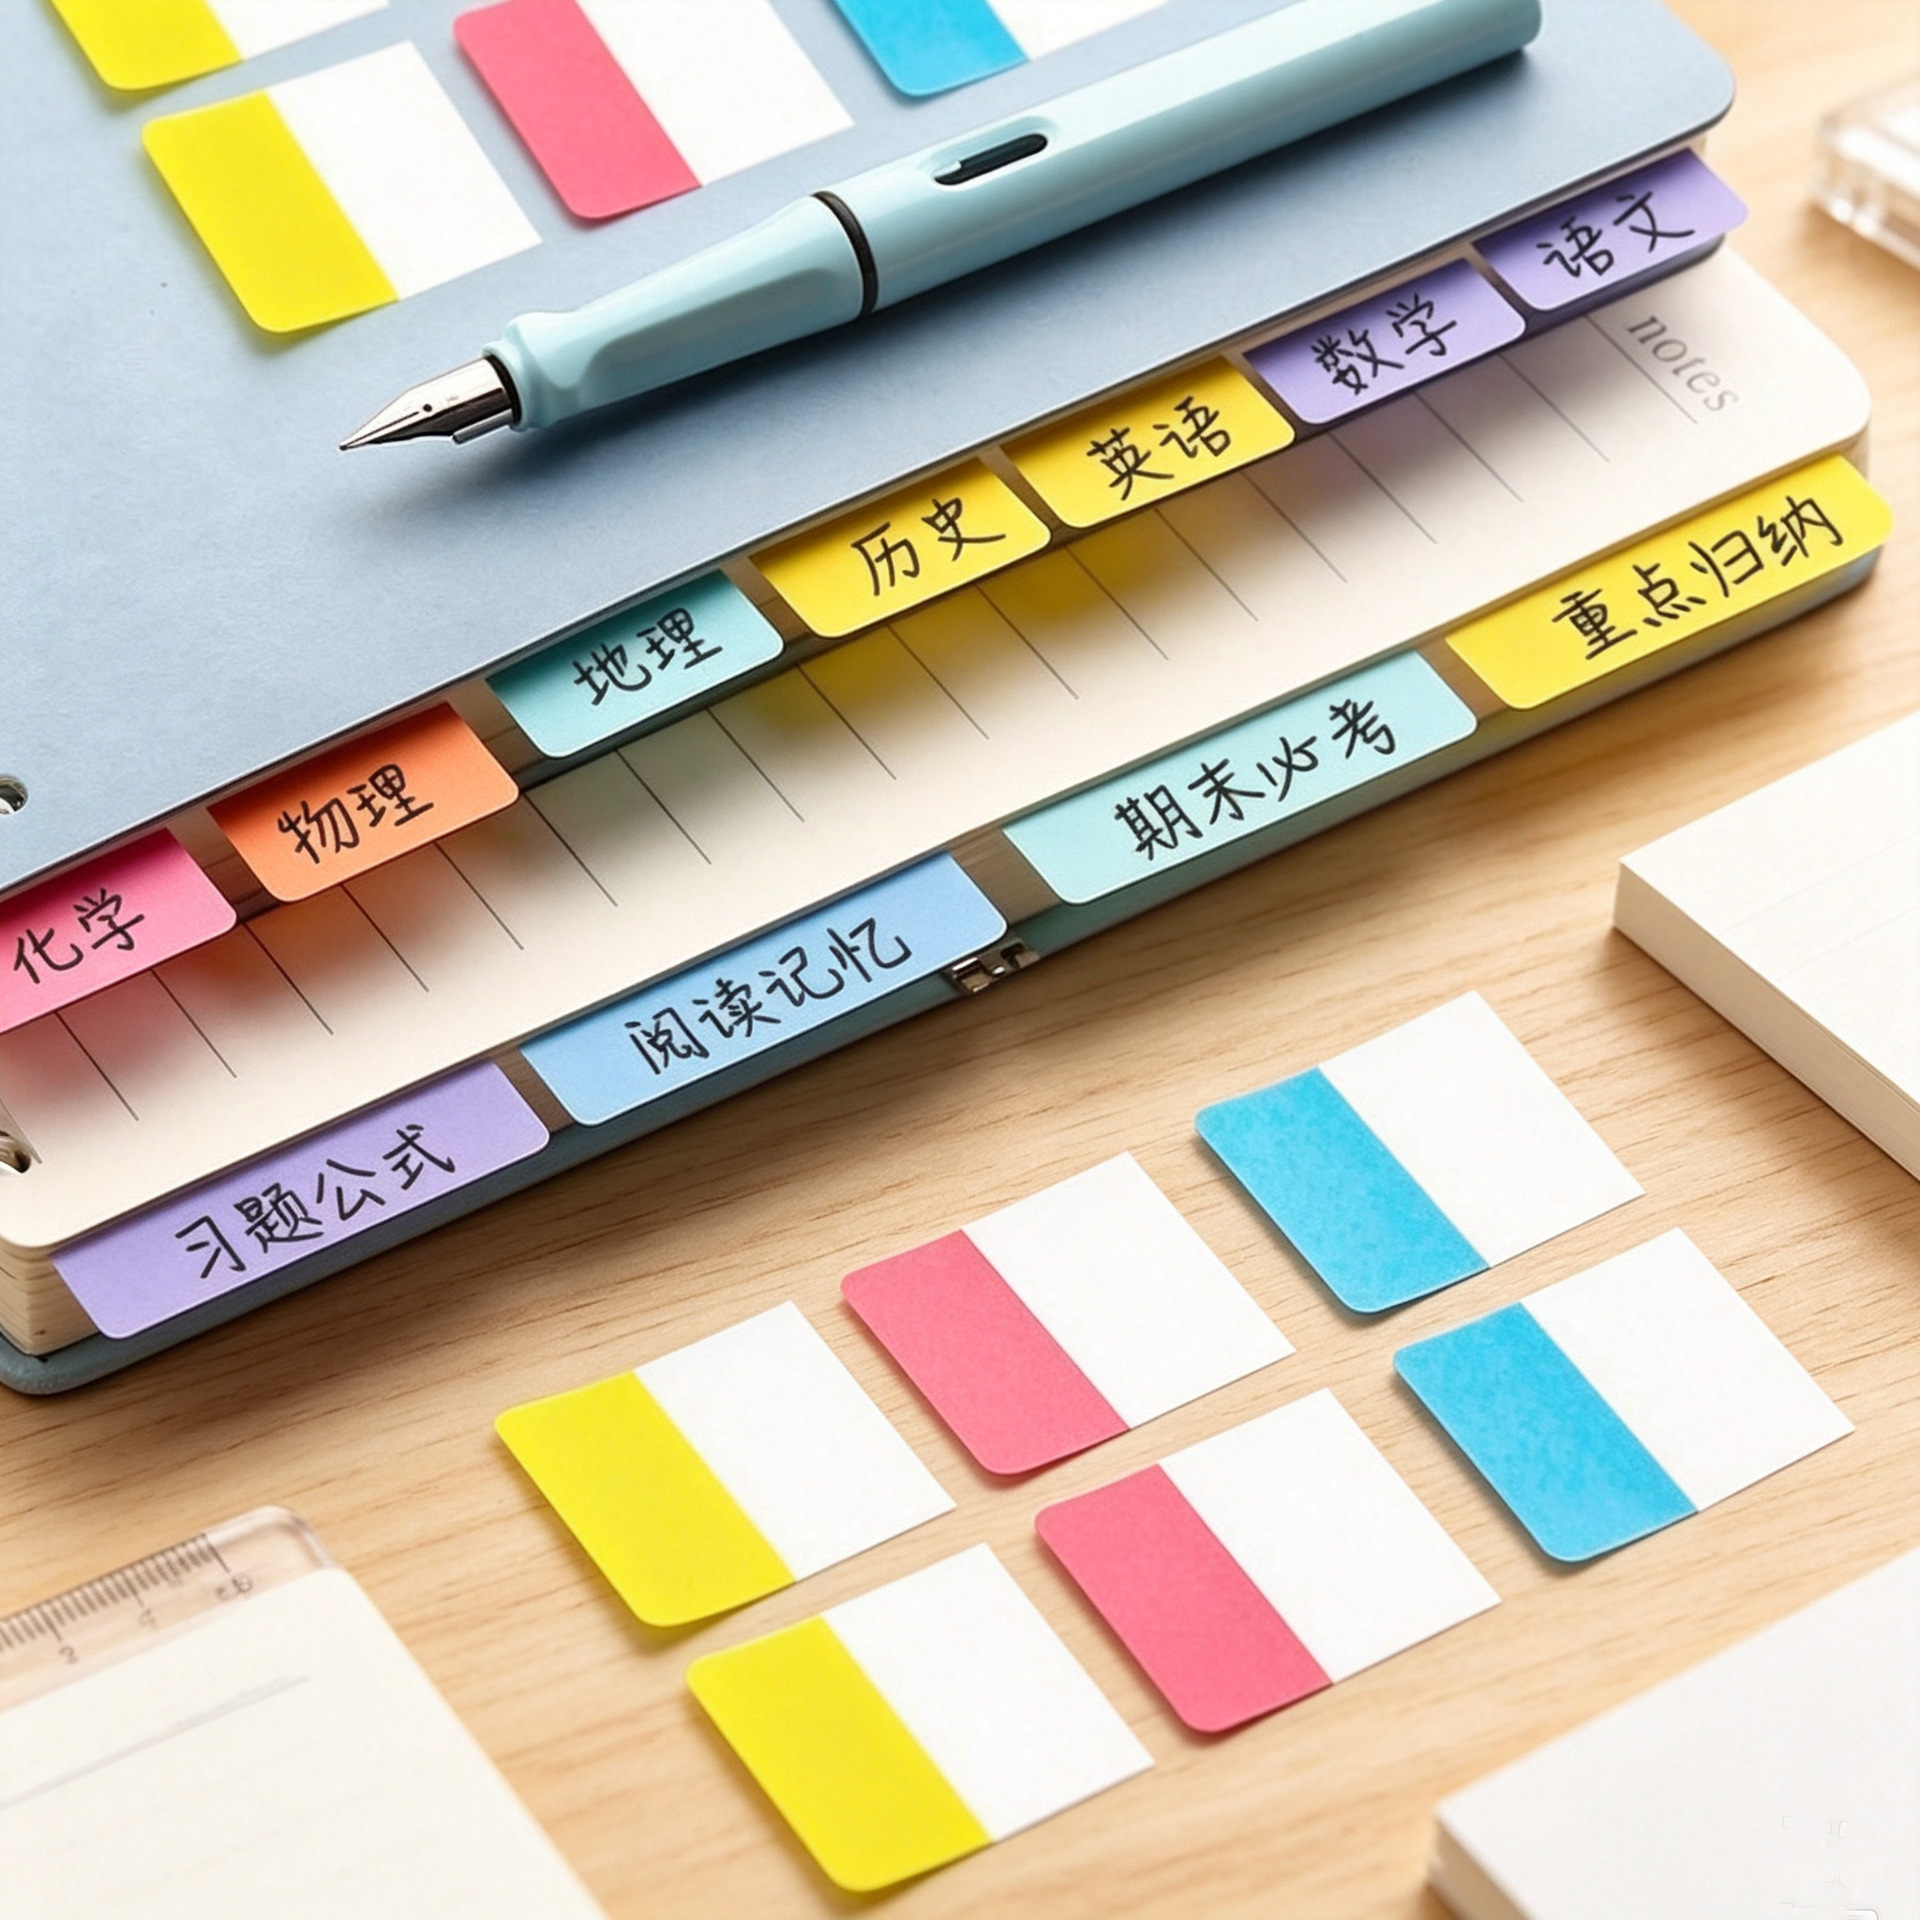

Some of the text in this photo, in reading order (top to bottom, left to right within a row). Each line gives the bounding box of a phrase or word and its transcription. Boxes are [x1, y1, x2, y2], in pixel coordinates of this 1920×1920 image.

[1536, 189, 1696, 280] 语文
[1310, 292, 1458, 396] 数学
[1626, 314, 1740, 412] notes
[1085, 395, 1232, 502] 英语
[849, 496, 1007, 597] 历史
[1550, 494, 1845, 662] 重点归纳
[572, 606, 724, 707] 地理
[276, 762, 434, 865] 物理
[1113, 696, 1398, 862] 期末必考
[13, 885, 145, 986] 化学
[623, 916, 913, 1076] 阅读记忆
[174, 1121, 457, 1280] 习题公式
